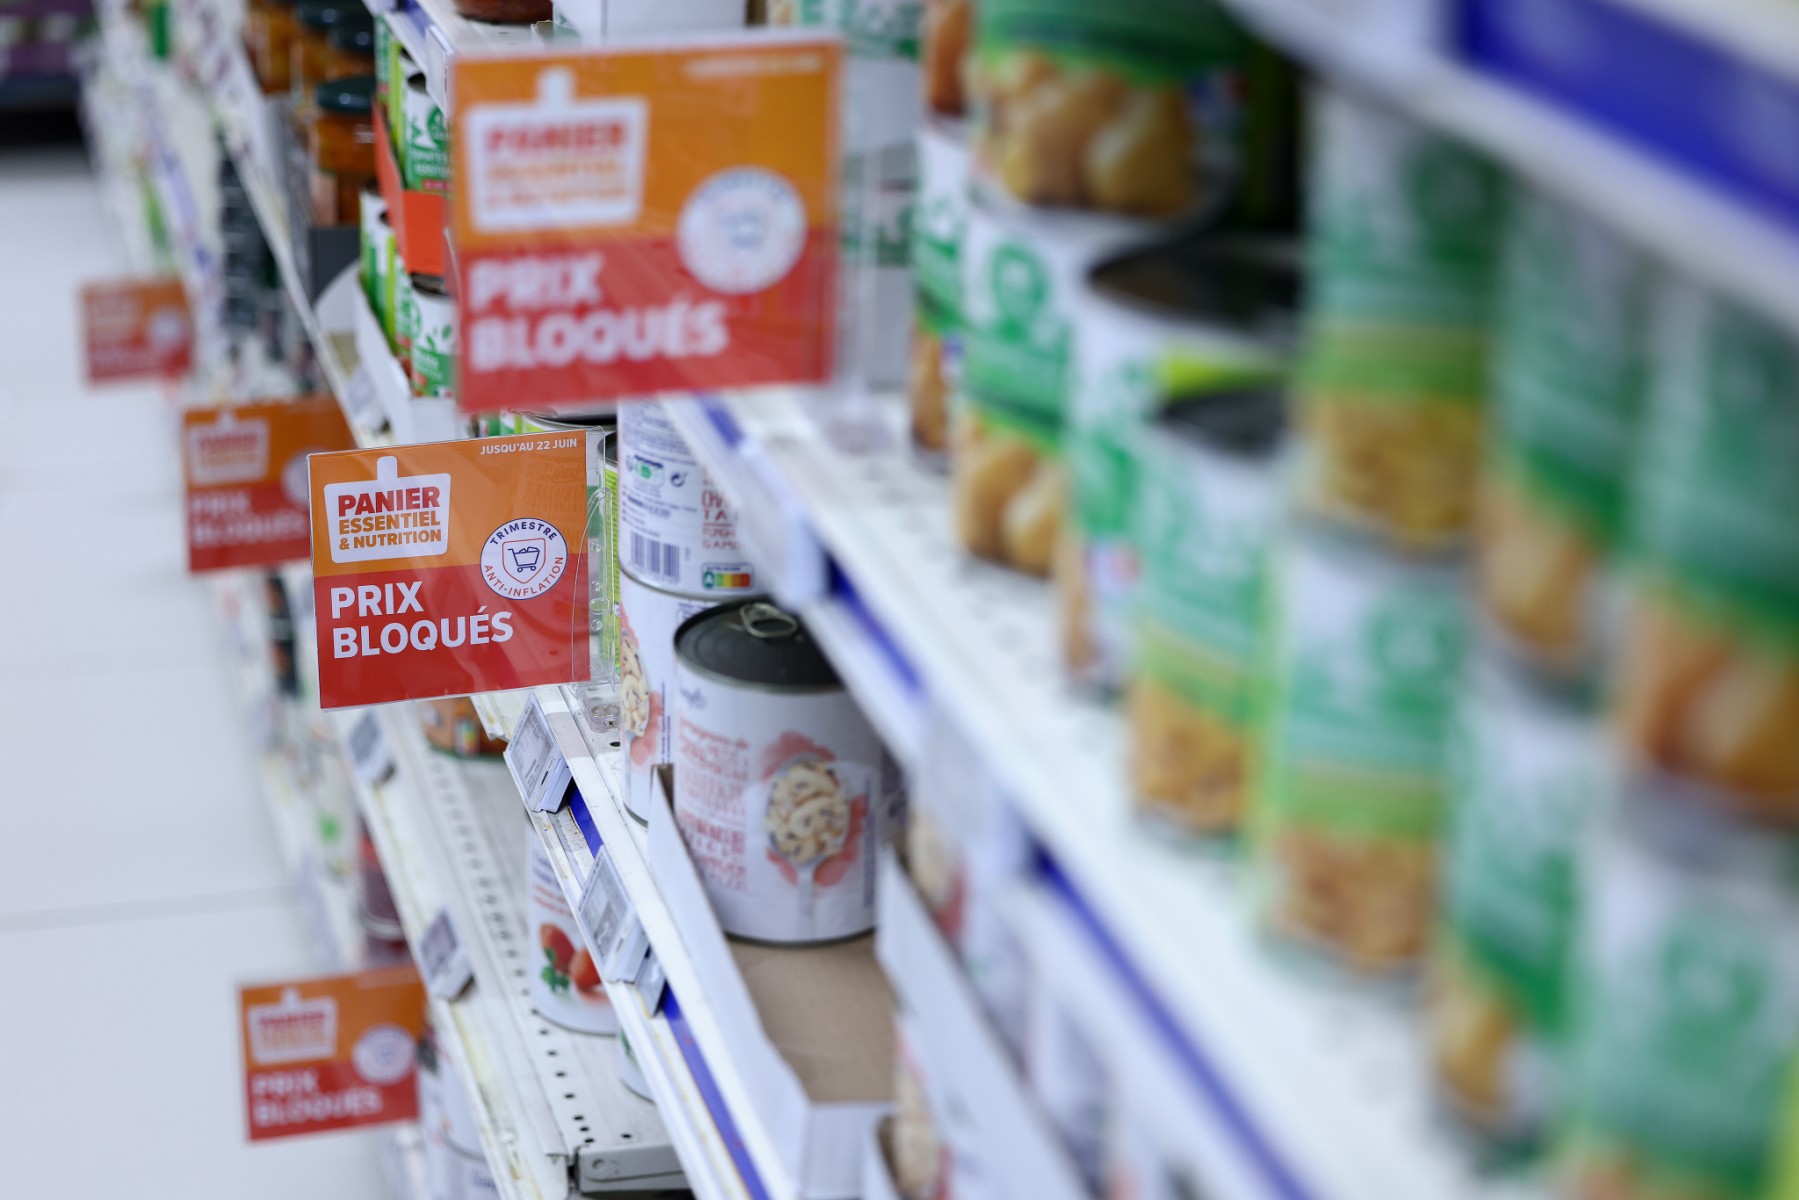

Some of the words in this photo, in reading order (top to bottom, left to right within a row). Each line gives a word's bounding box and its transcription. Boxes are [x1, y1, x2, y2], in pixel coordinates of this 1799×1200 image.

[469, 253, 603, 313] PRIX
[468, 290, 730, 373] BLOQUÉS
[480, 442, 534, 455] JUSQU'AU
[536, 440, 550, 451] 22
[552, 438, 577, 449] JUIN
[338, 486, 440, 517] PANIER
[339, 510, 441, 535] ESSENTIEL
[339, 537, 350, 550] &
[353, 529, 442, 549] NUTRITION
[490, 521, 557, 545] TRIMESTRE
[484, 556, 564, 597] ANTI-INFLATION
[330, 581, 424, 619] PRIX
[332, 605, 514, 659] BLOQUÉS
